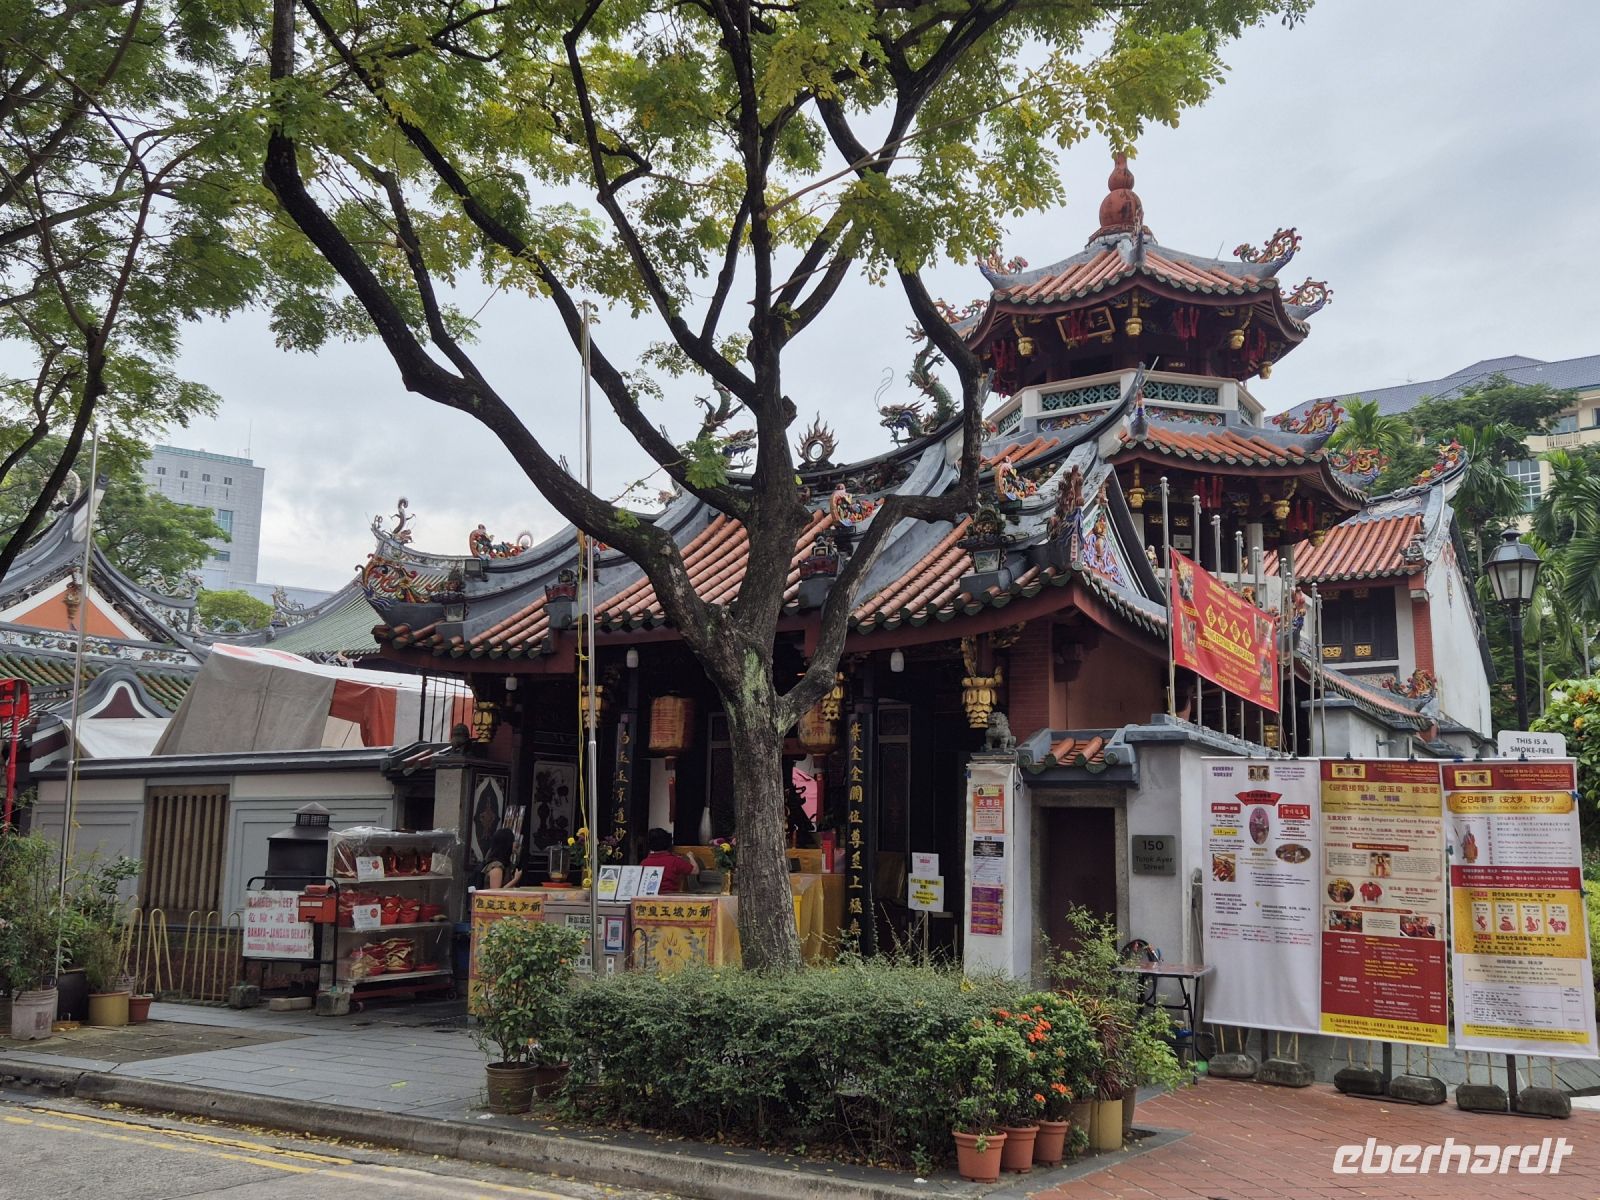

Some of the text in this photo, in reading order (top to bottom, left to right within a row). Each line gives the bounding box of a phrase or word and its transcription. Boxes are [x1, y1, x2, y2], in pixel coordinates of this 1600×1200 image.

[1516, 737, 1532, 745] THIS
[1510, 746, 1554, 755] SMOKE-FREE
[1142, 840, 1164, 850] 150
[1135, 855, 1173, 865] Telok Ayer
